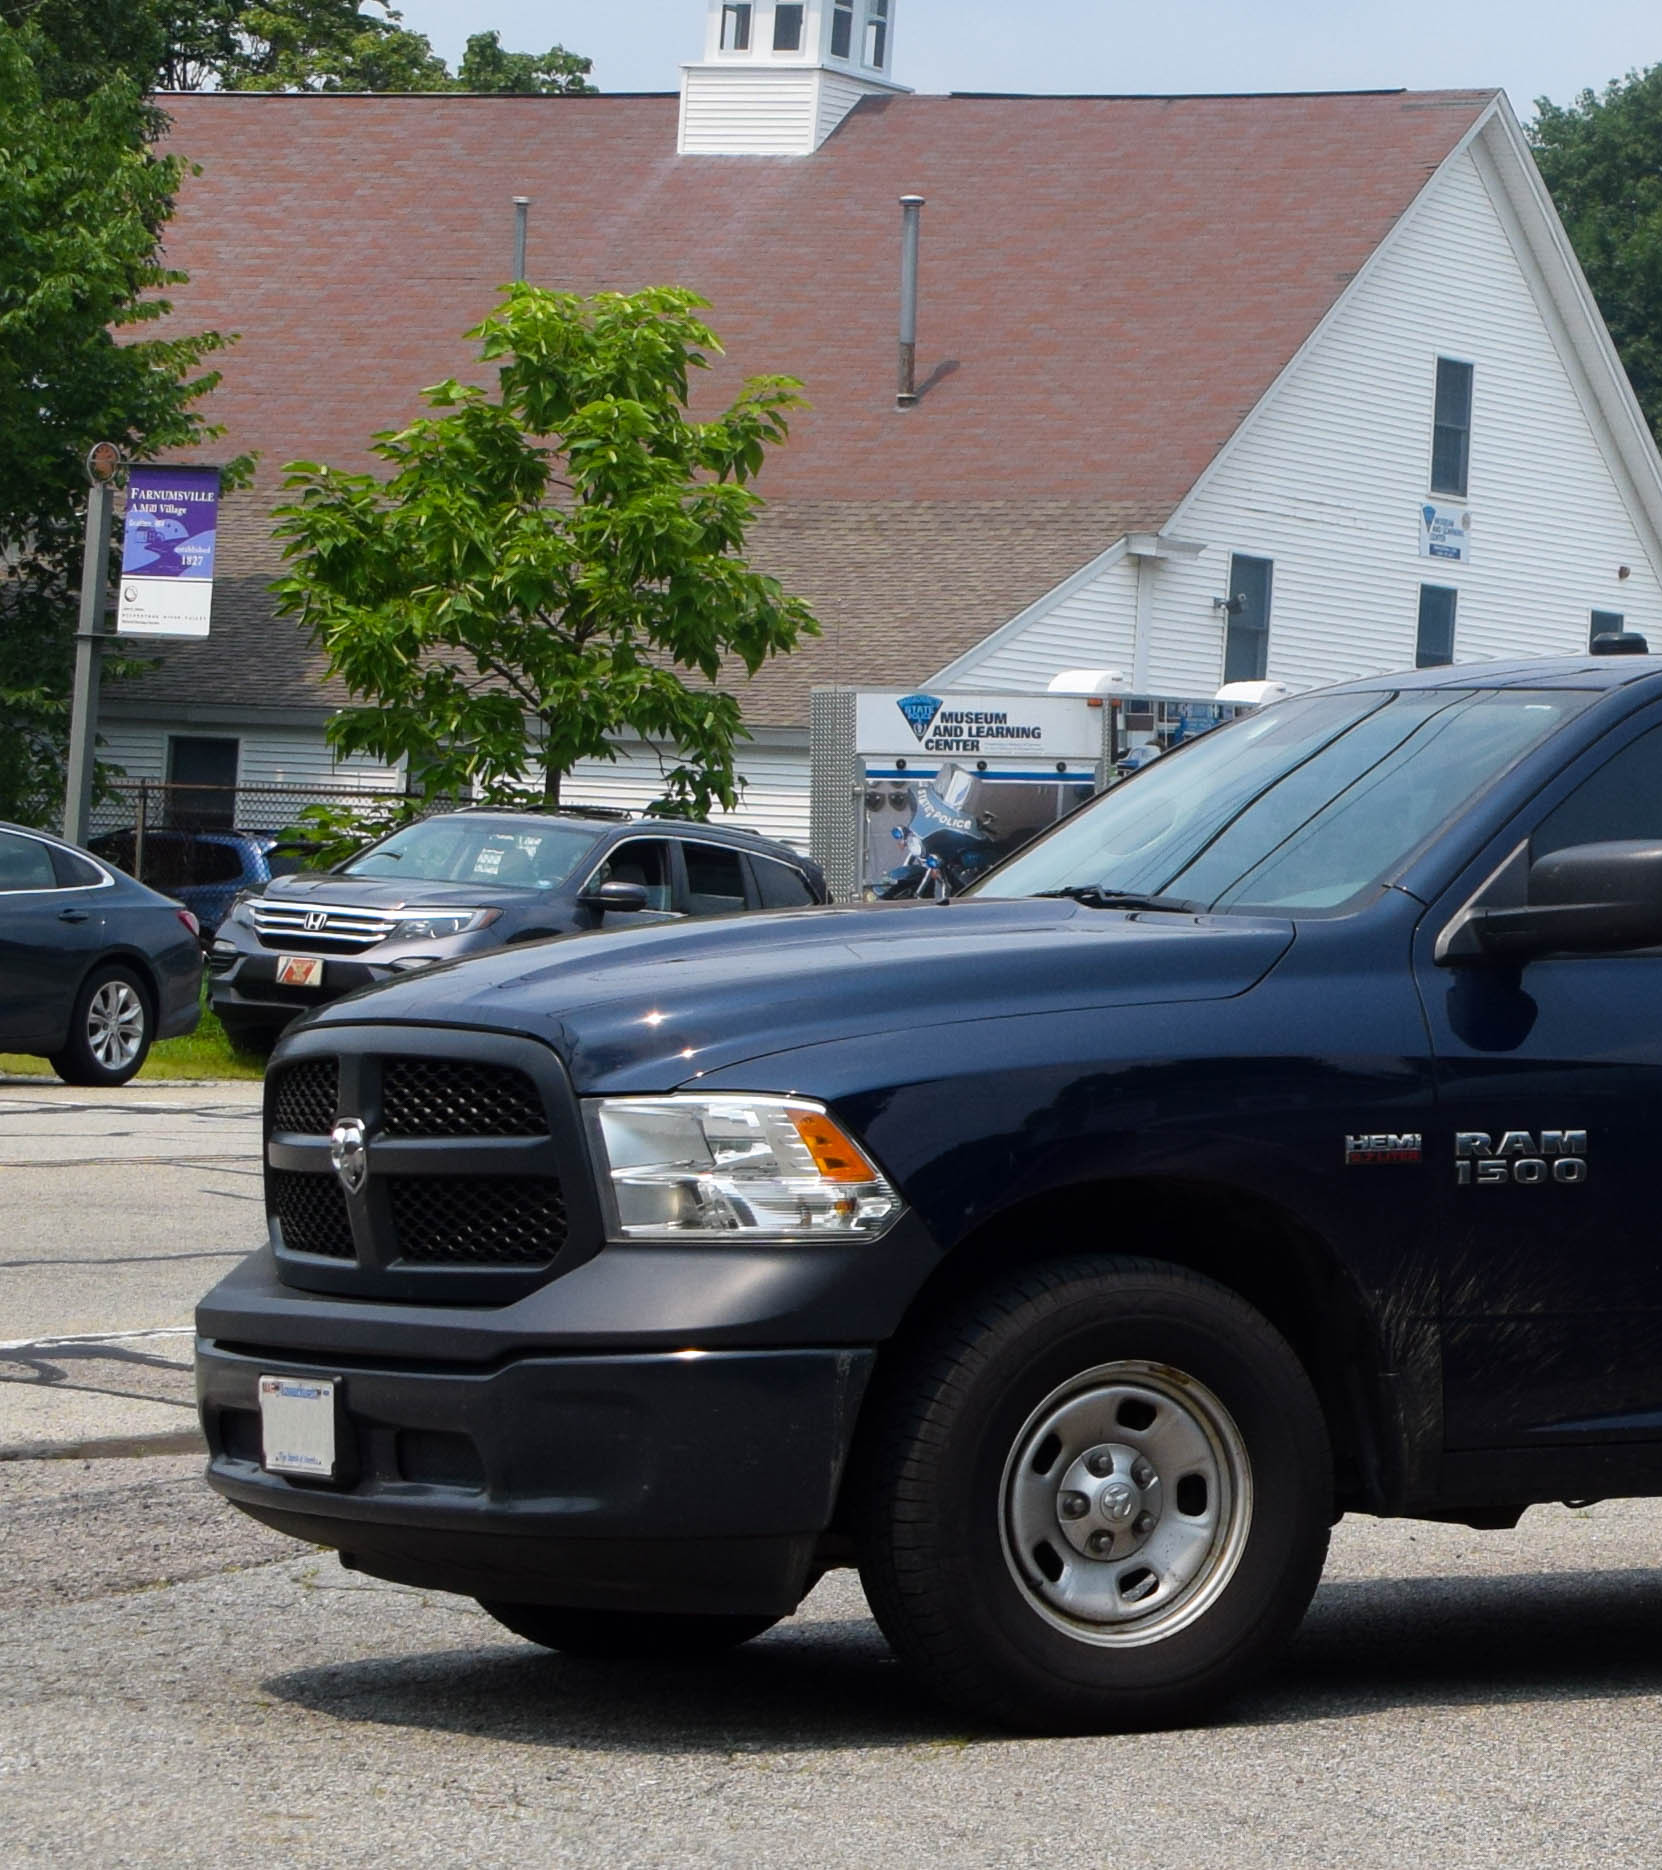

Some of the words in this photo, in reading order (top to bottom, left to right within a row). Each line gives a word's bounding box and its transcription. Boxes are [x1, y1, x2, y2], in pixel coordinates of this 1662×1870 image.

[131, 488, 215, 502] FARNUMSVILLE
[131, 503, 139, 512] A
[140, 503, 157, 513] Mill
[160, 503, 187, 516] Village
[181, 554, 204, 566] 1827
[940, 711, 1007, 724] MUSEUM
[932, 724, 964, 738] AND
[968, 725, 1041, 739] LEARNING
[925, 738, 980, 751] CENTER
[932, 811, 972, 830] POLICE
[1344, 1133, 1422, 1151] HEMI
[1455, 1130, 1587, 1156] RAM
[1455, 1157, 1587, 1185] 1500
